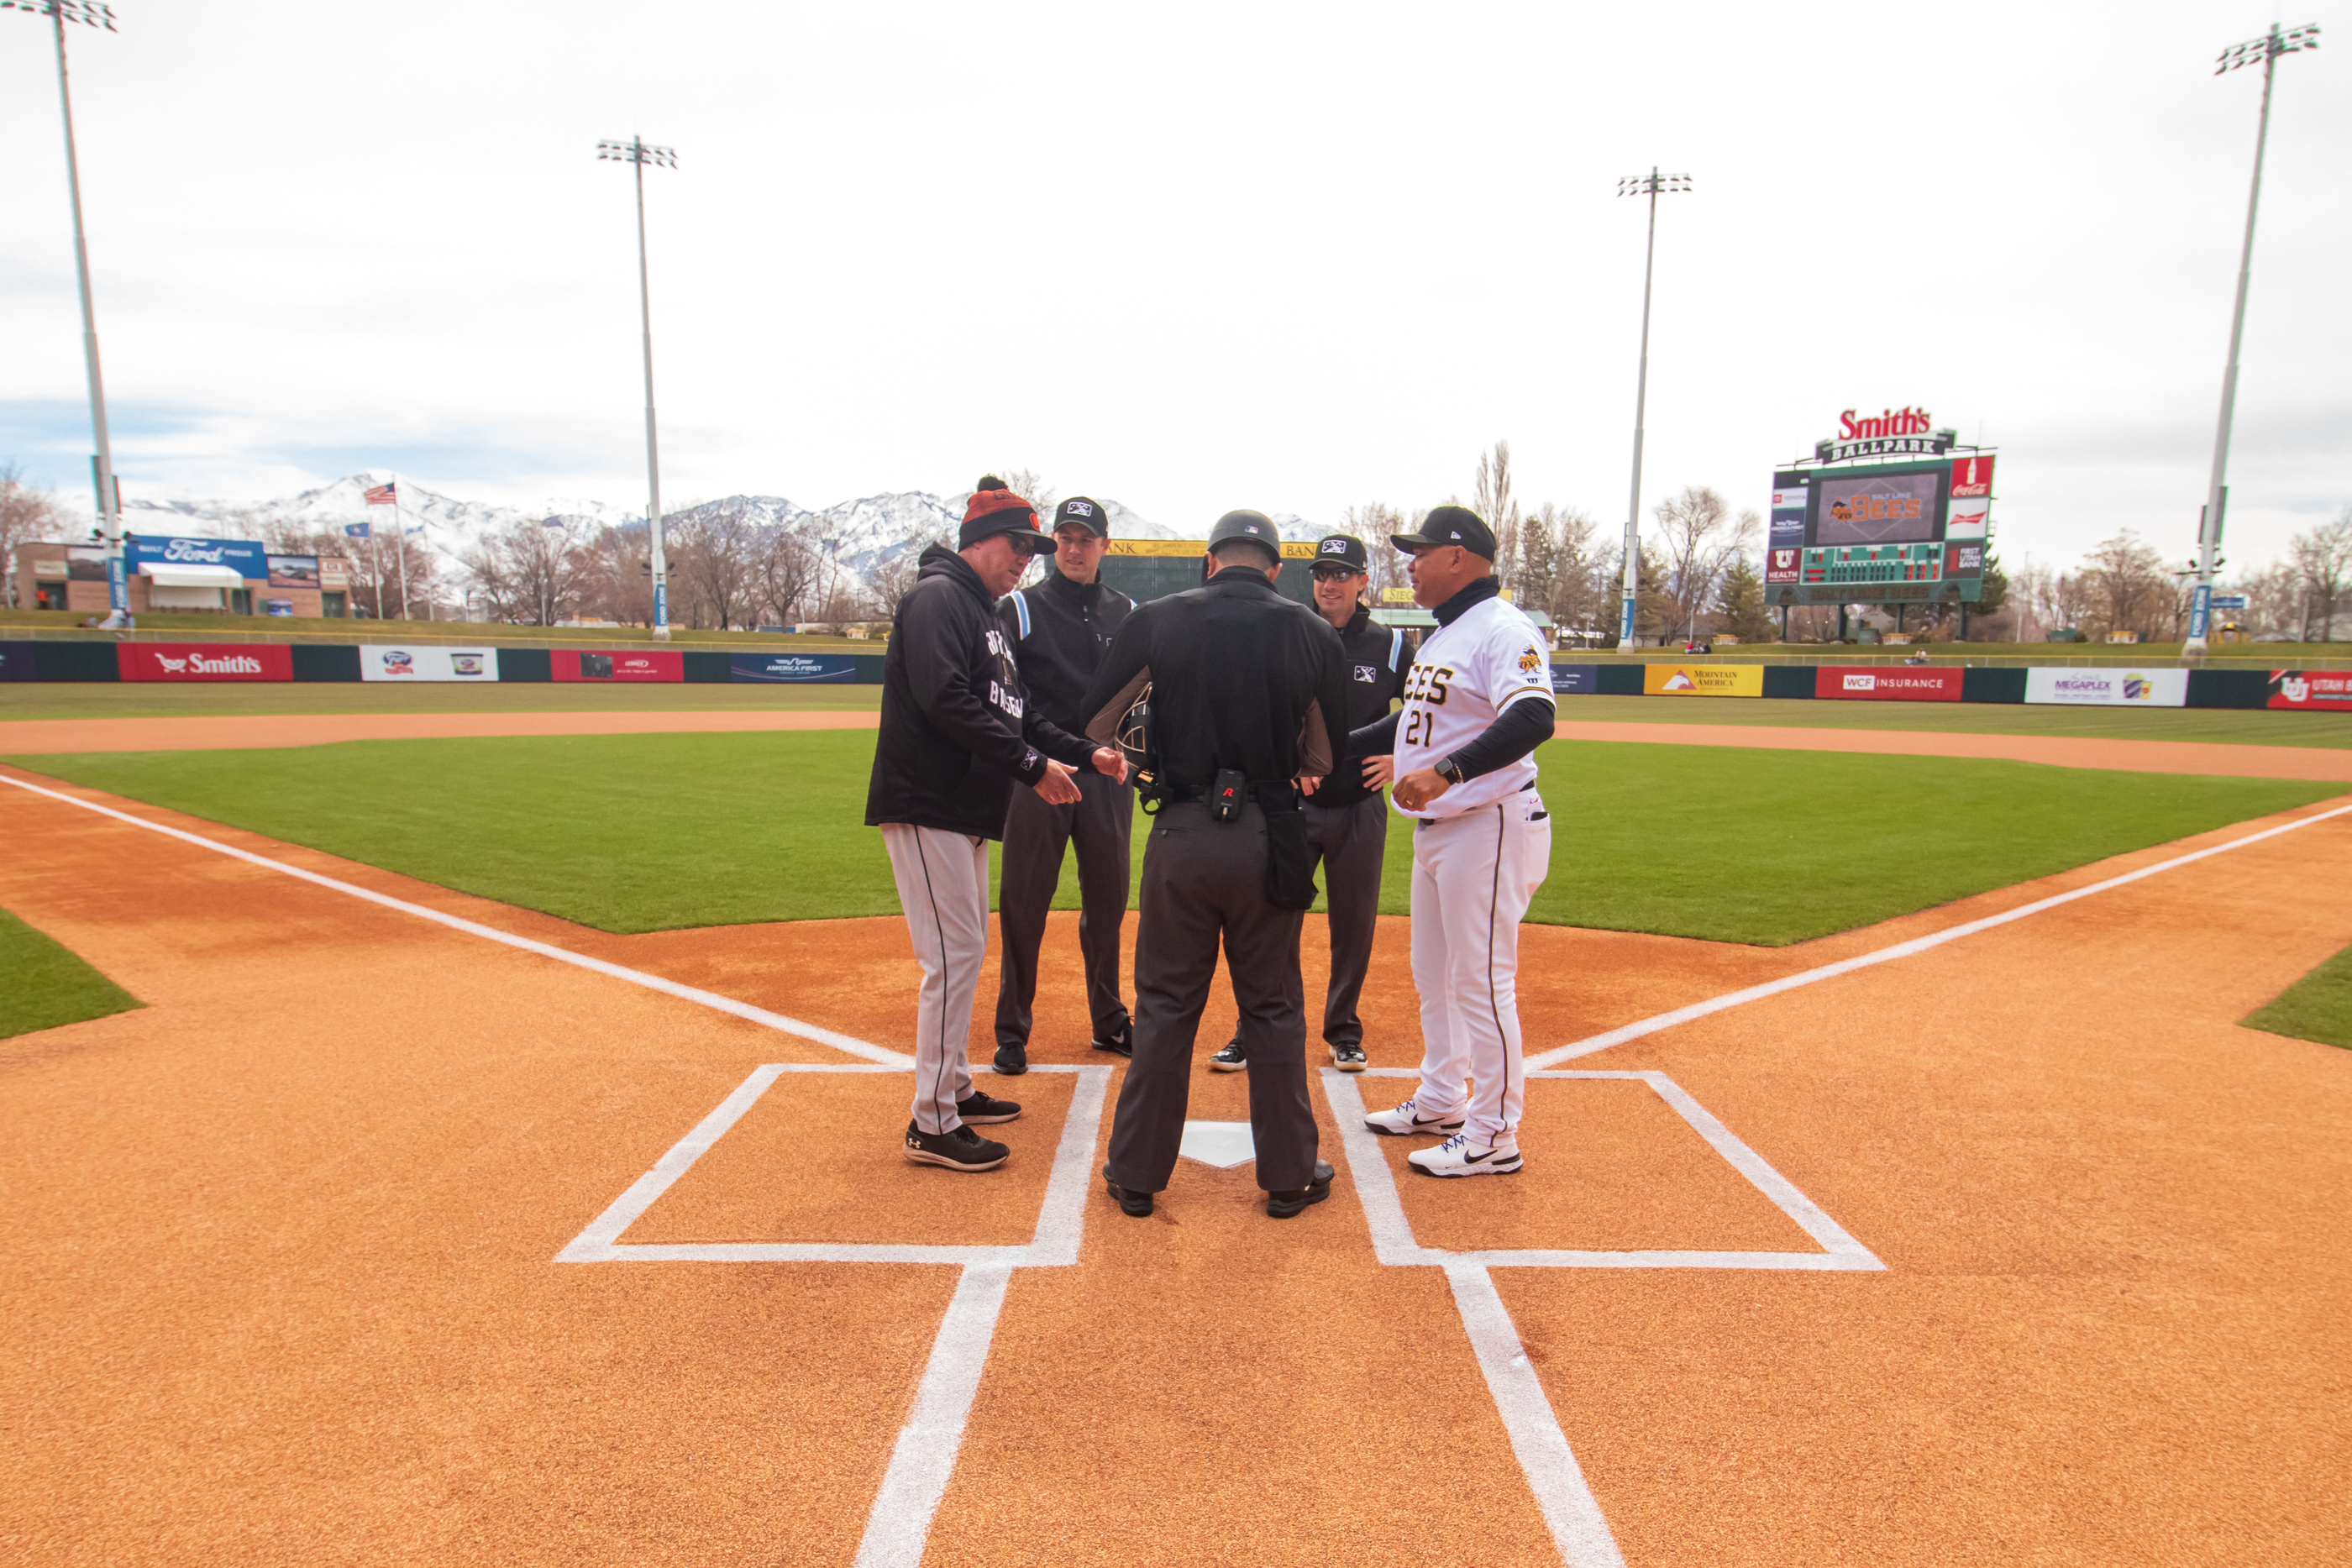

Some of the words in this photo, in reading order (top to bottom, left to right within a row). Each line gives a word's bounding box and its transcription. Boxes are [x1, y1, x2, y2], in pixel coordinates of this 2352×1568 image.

[1838, 406, 1930, 441] Smith's
[1830, 438, 1935, 461] BALLPARK
[164, 538, 224, 563] Ford
[1108, 542, 1137, 554] ANK
[1286, 545, 1315, 557] BAN
[1768, 571, 1798, 579] HEALTH
[189, 653, 262, 674] Smith's
[1694, 670, 1737, 679] MOUNTAIN
[1404, 660, 1455, 706] EES
[1846, 678, 1872, 687] WCF
[1877, 679, 1943, 689] INSURANCE
[2055, 680, 2111, 690] MEGAPLEX
[1405, 709, 1434, 747] 21
